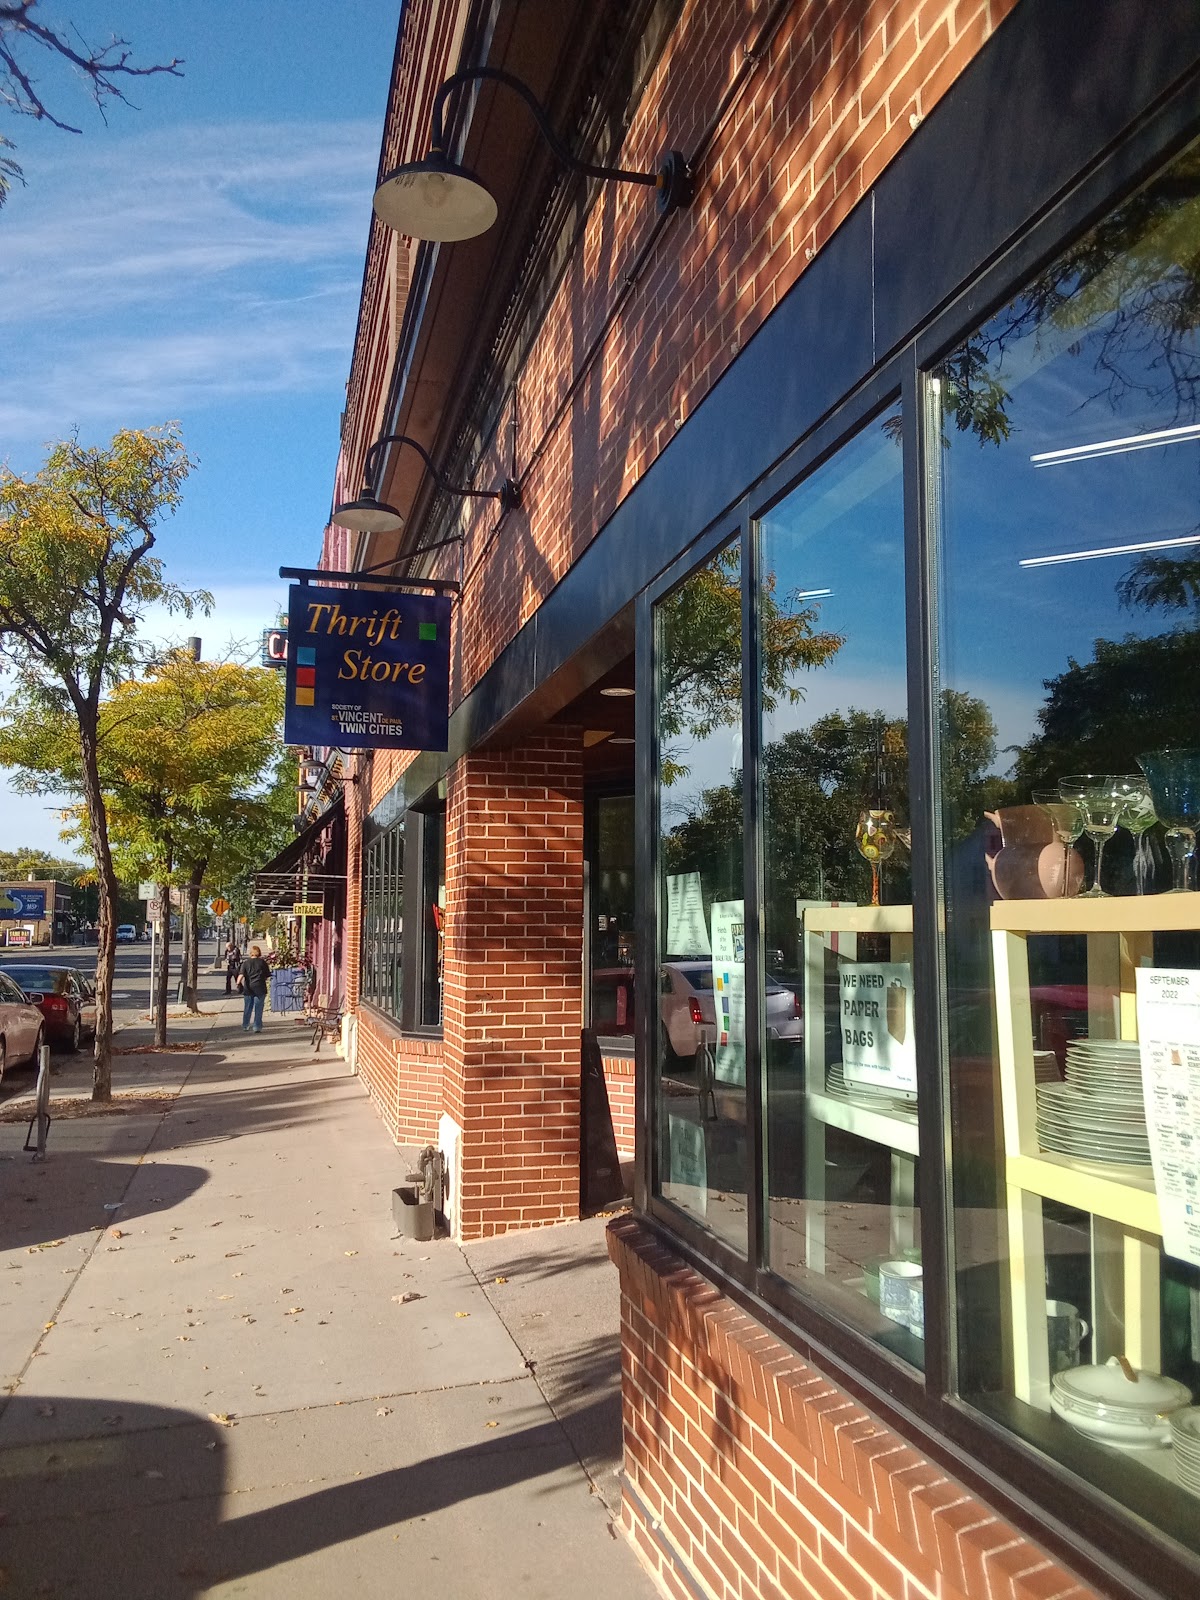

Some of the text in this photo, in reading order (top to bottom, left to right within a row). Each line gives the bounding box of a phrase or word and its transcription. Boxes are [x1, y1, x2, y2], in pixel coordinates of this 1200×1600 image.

[305, 603, 403, 646] Thrift
[337, 649, 427, 684] Store
[331, 703, 353, 711] SOCIETY
[338, 710, 384, 724] VINCENT
[339, 722, 403, 736] TWIN CITIES
[294, 904, 324, 915] ENTRANCE
[842, 974, 884, 988] WE NEED
[1149, 975, 1190, 986] SEPTEMBER
[1161, 989, 1179, 999] 2022
[844, 1000, 879, 1018] PAPER
[845, 1028, 874, 1048] BAGS
